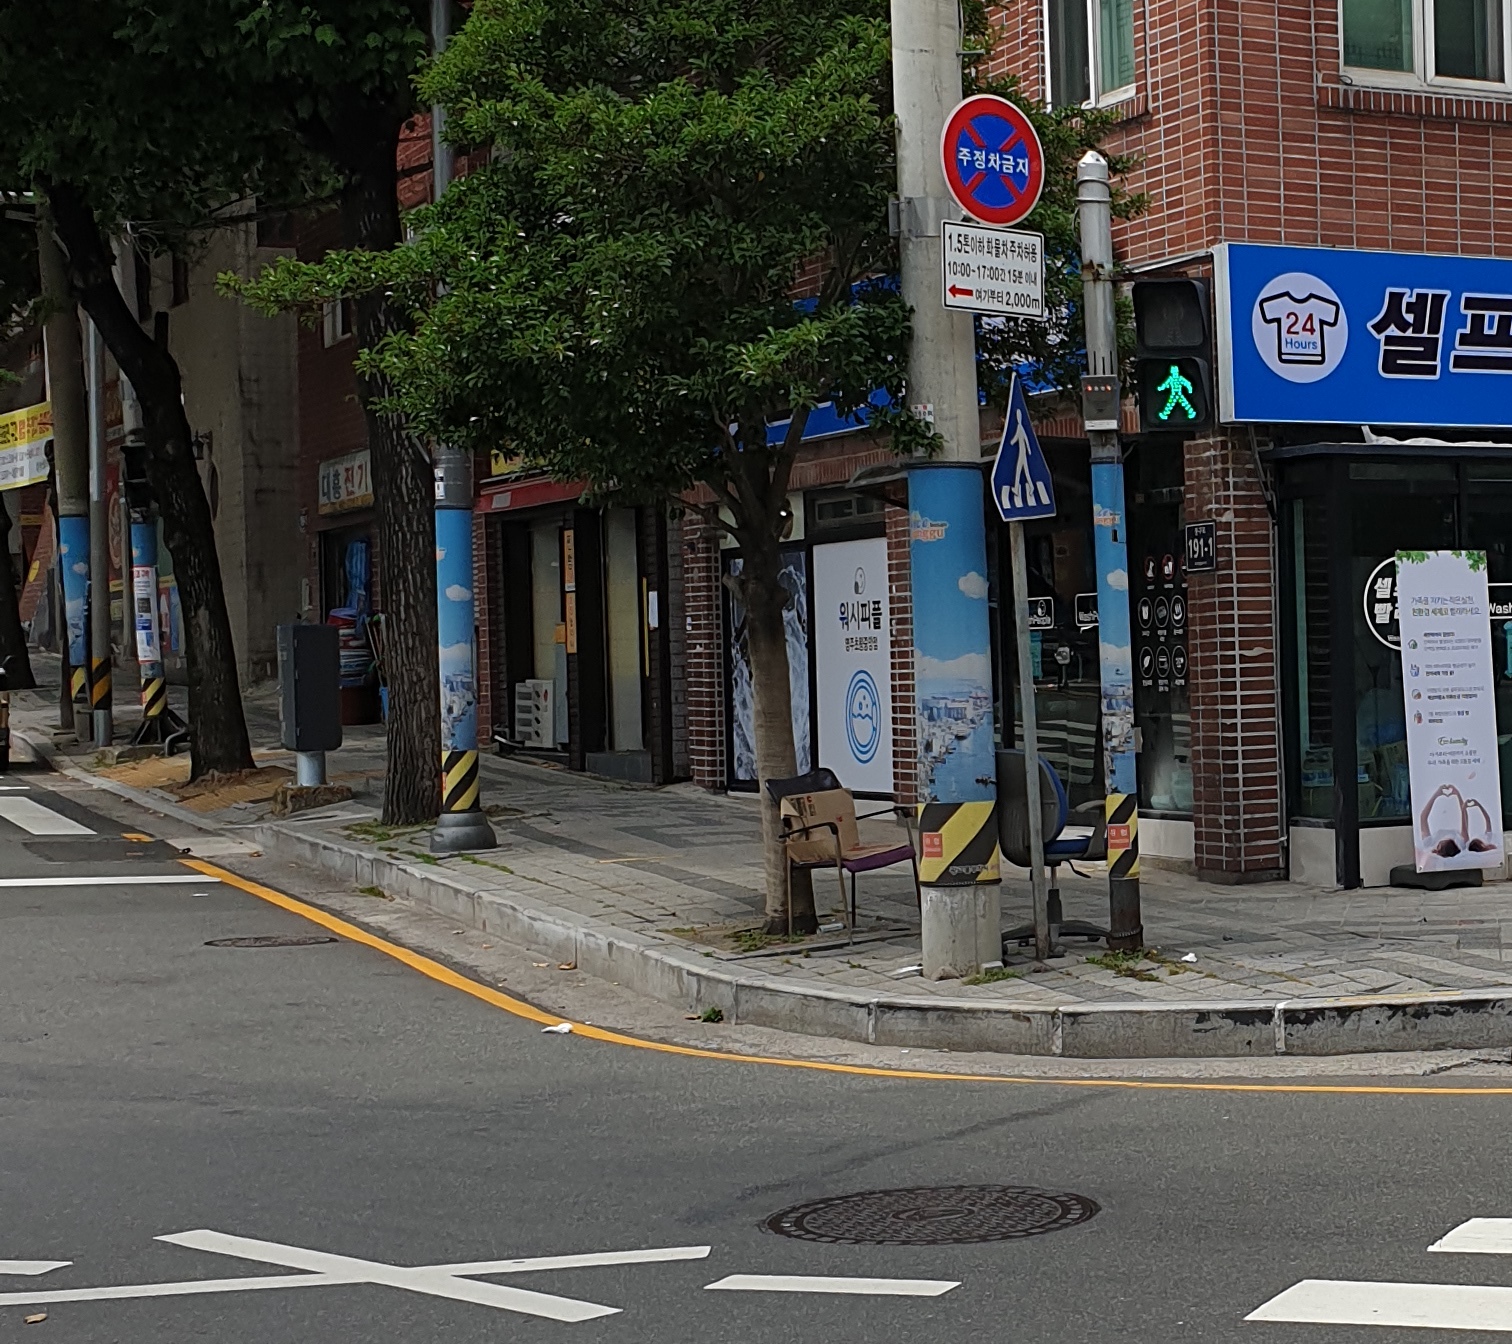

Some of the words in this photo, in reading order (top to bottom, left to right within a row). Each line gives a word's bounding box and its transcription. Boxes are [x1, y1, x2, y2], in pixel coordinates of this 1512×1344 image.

[958, 147, 1029, 177] 주정차금지
[986, 237, 1008, 259] 화물차
[1008, 240, 1038, 263] 주차허용
[1008, 269, 1023, 285] 15분
[1025, 270, 1037, 286] 이내
[975, 288, 1004, 305] 여기부터
[1005, 291, 1040, 310] 2,000m
[1286, 312, 1316, 335] 24
[1285, 338, 1318, 350] Hours
[1188, 537, 1213, 559] 191-1
[839, 600, 882, 631] 워시피플
